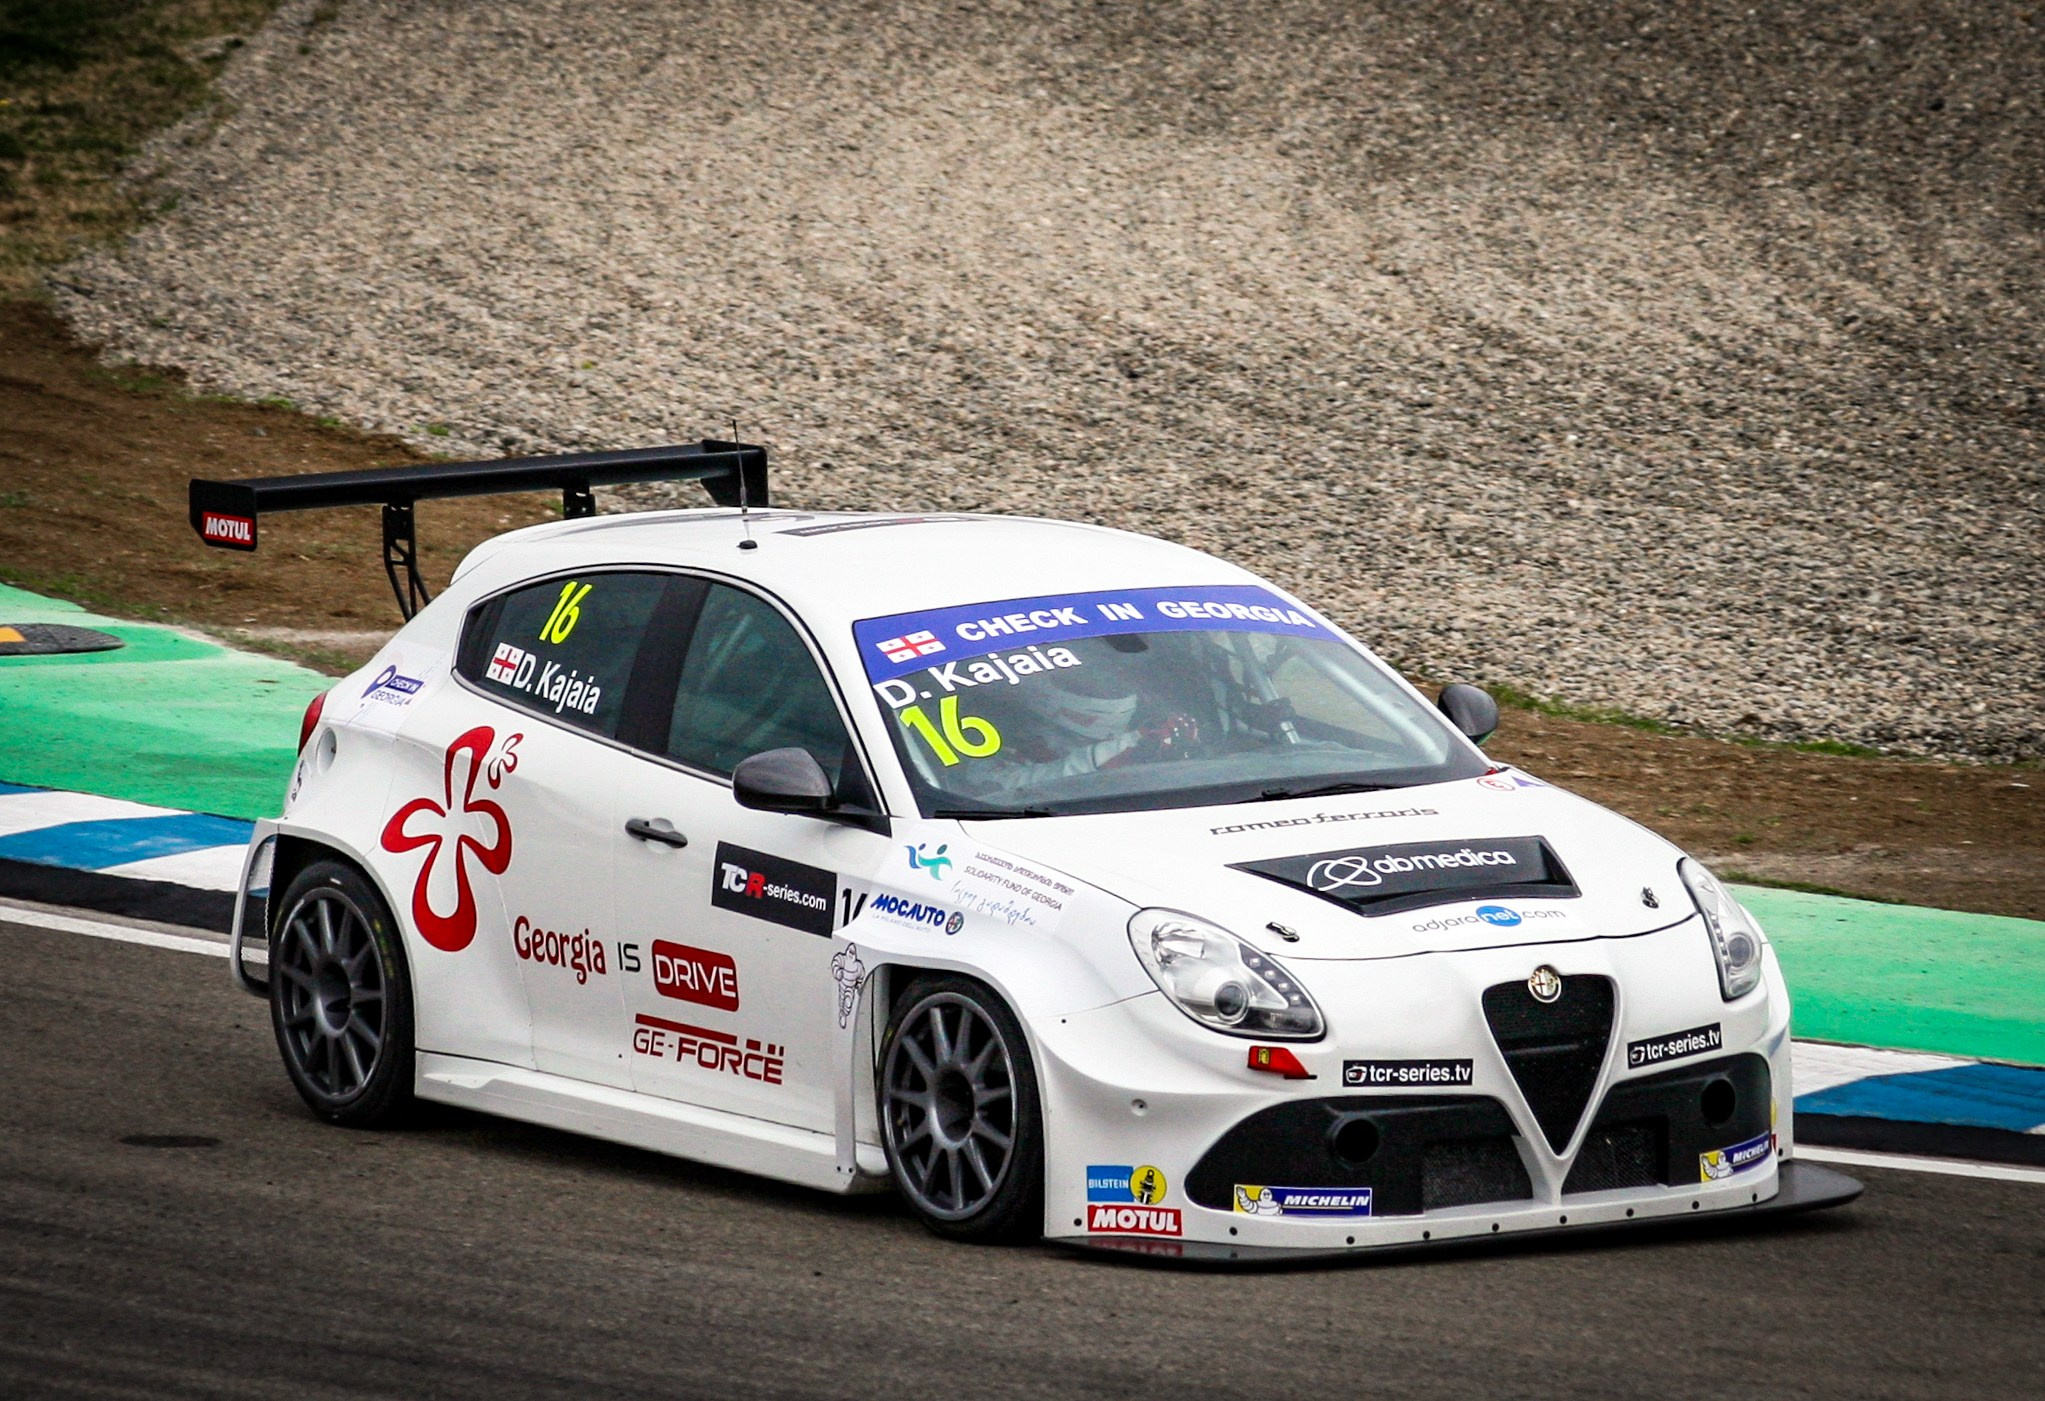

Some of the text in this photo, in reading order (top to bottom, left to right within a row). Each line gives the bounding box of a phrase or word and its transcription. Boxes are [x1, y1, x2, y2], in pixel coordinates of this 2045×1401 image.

[205, 516, 251, 541] MOTUL
[538, 580, 593, 645] 16
[955, 601, 1317, 641] CHECK IN GEORGIA
[512, 652, 601, 715] D. Kajaia
[872, 645, 1083, 710] D. Kajaia
[899, 694, 1002, 768] 16
[720, 862, 827, 912] TCR-series.com
[1031, 890, 1063, 912] GEORGIA
[869, 893, 946, 927] MOCAUTO
[513, 915, 736, 998] Georgia IS DRIVE
[1658, 1029, 1721, 1060] tcr-series.tv
[1369, 1063, 1471, 1083] tcr-series.tv
[1088, 1178, 1129, 1189] BILSTEIN
[1284, 1194, 1370, 1206] MICHELIN
[1092, 1208, 1178, 1232] MOTUL
